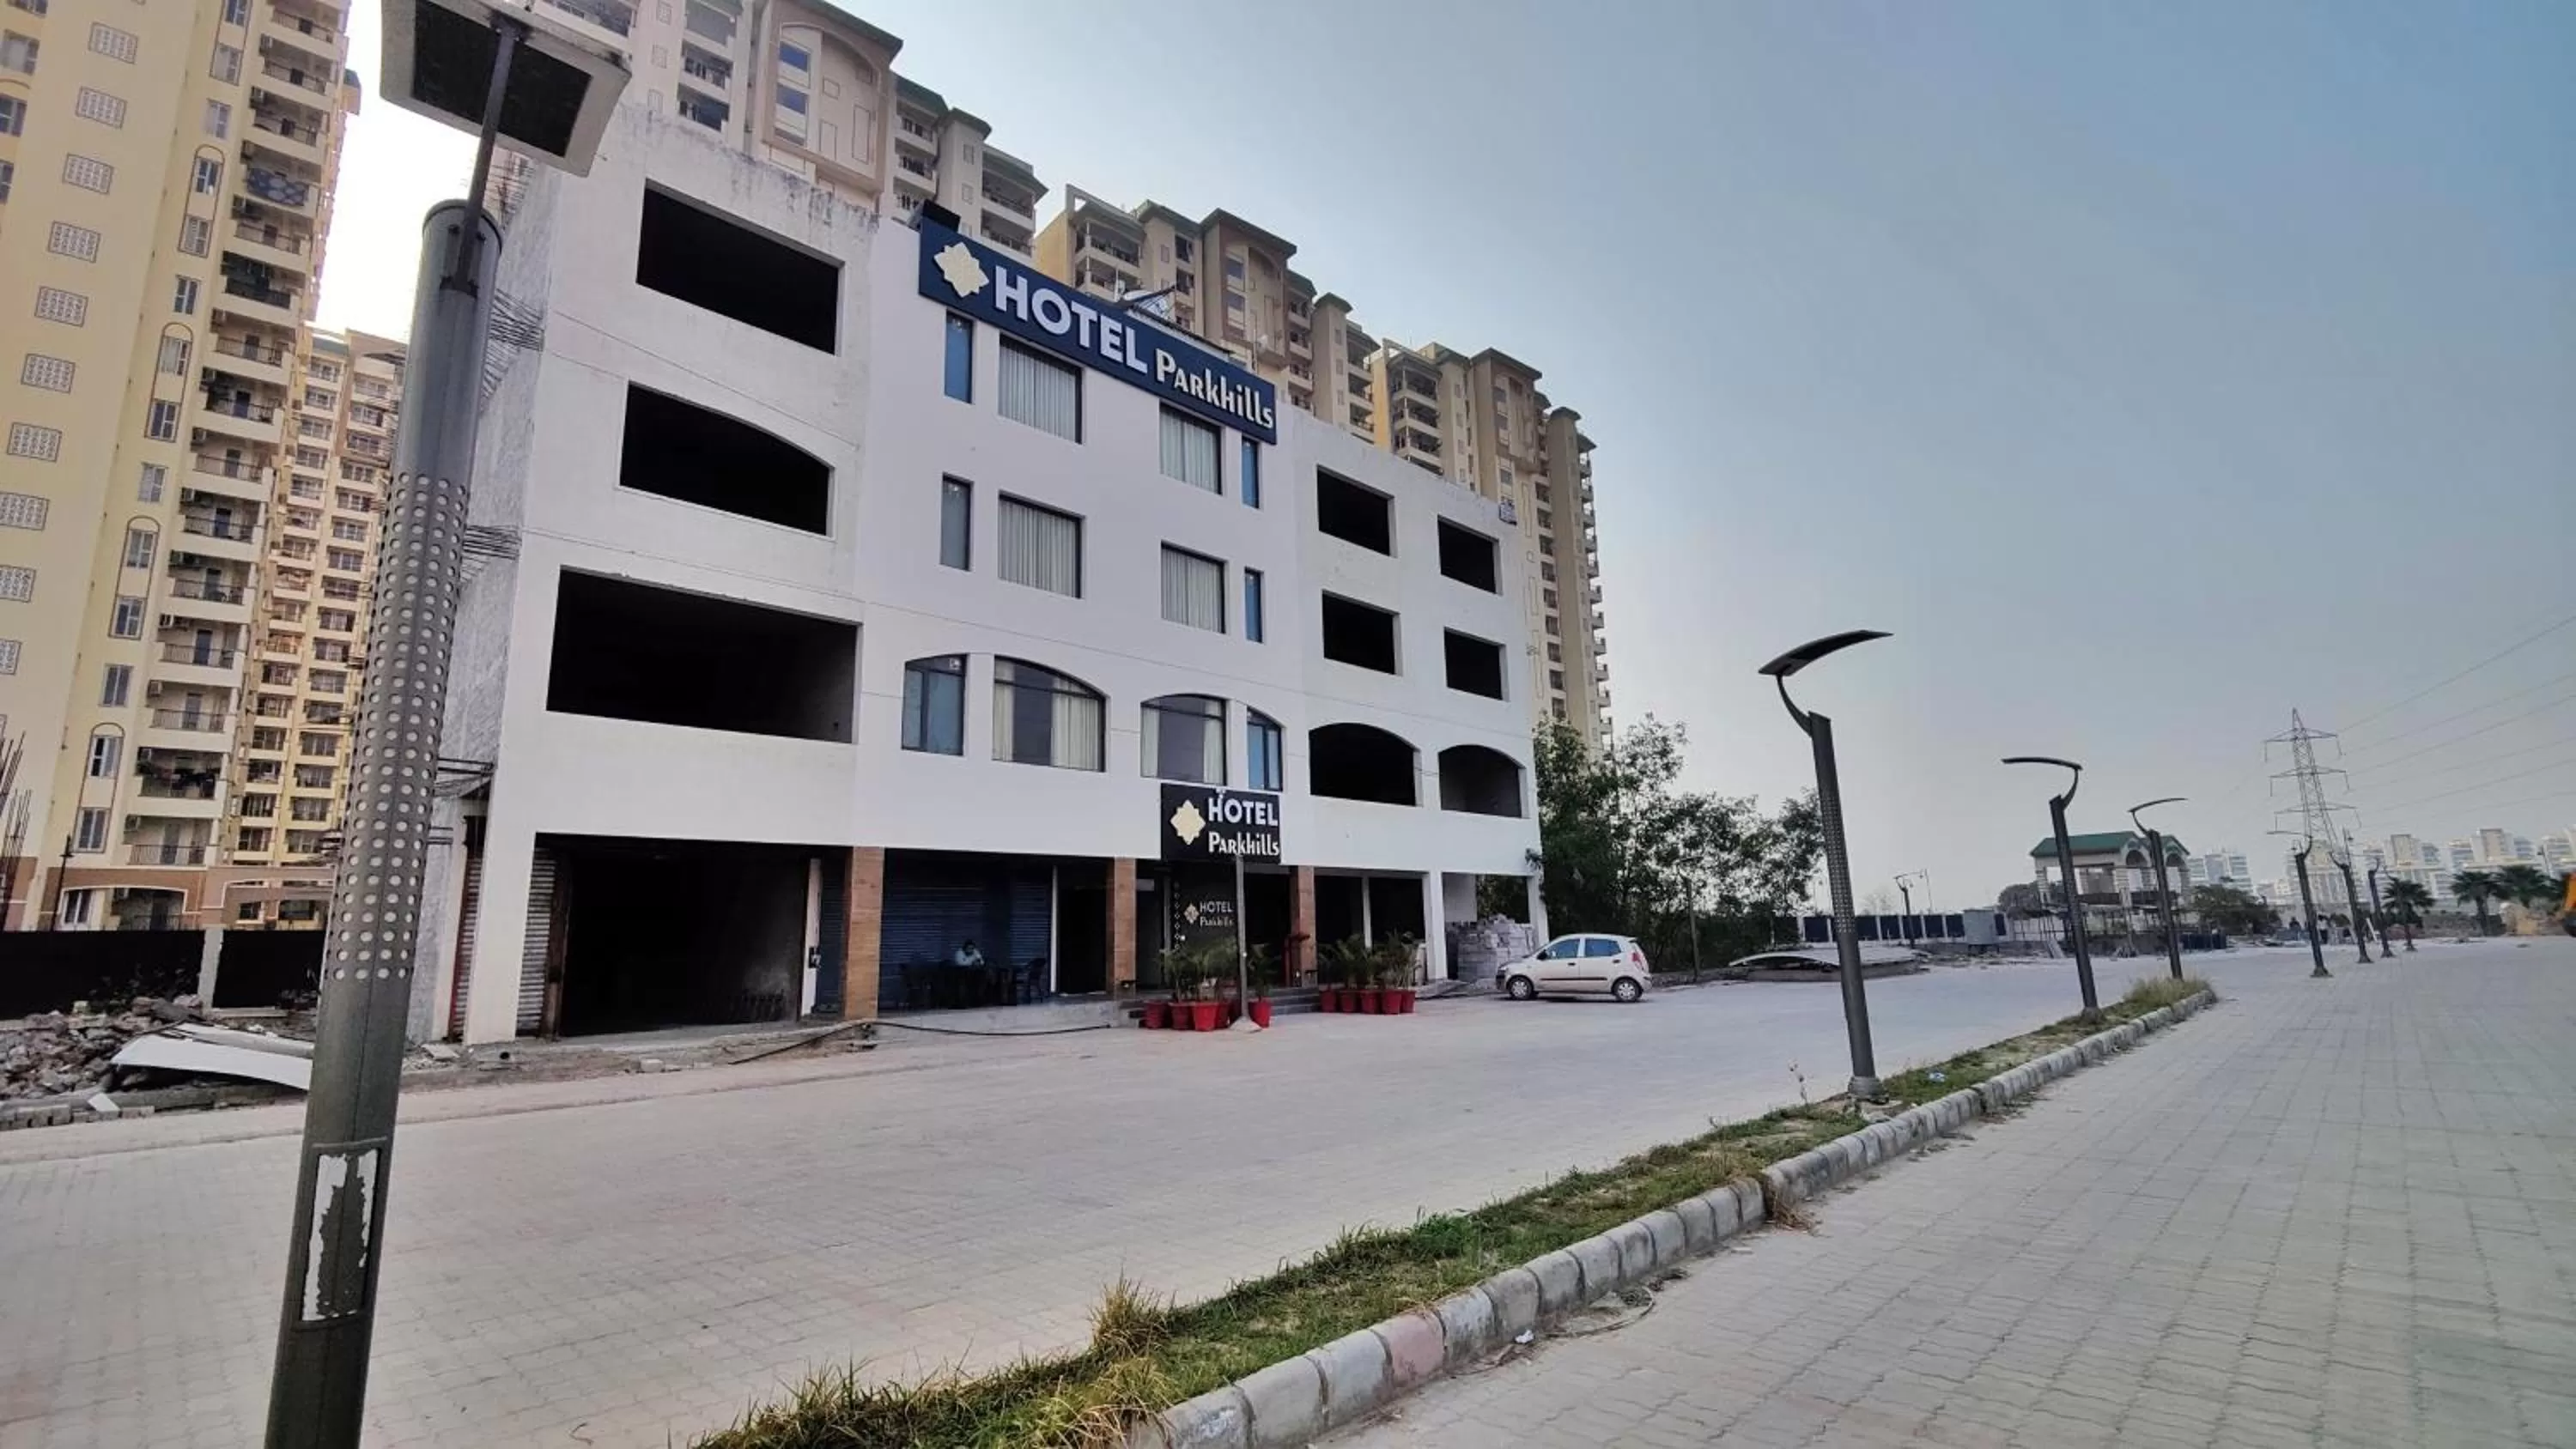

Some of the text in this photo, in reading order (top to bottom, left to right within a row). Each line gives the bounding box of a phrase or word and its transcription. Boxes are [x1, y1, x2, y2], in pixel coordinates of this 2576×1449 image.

[994, 265, 1148, 373] HOTEL
[1208, 797, 1279, 826] HOTEL
[1200, 900, 1233, 912] HOTEL
